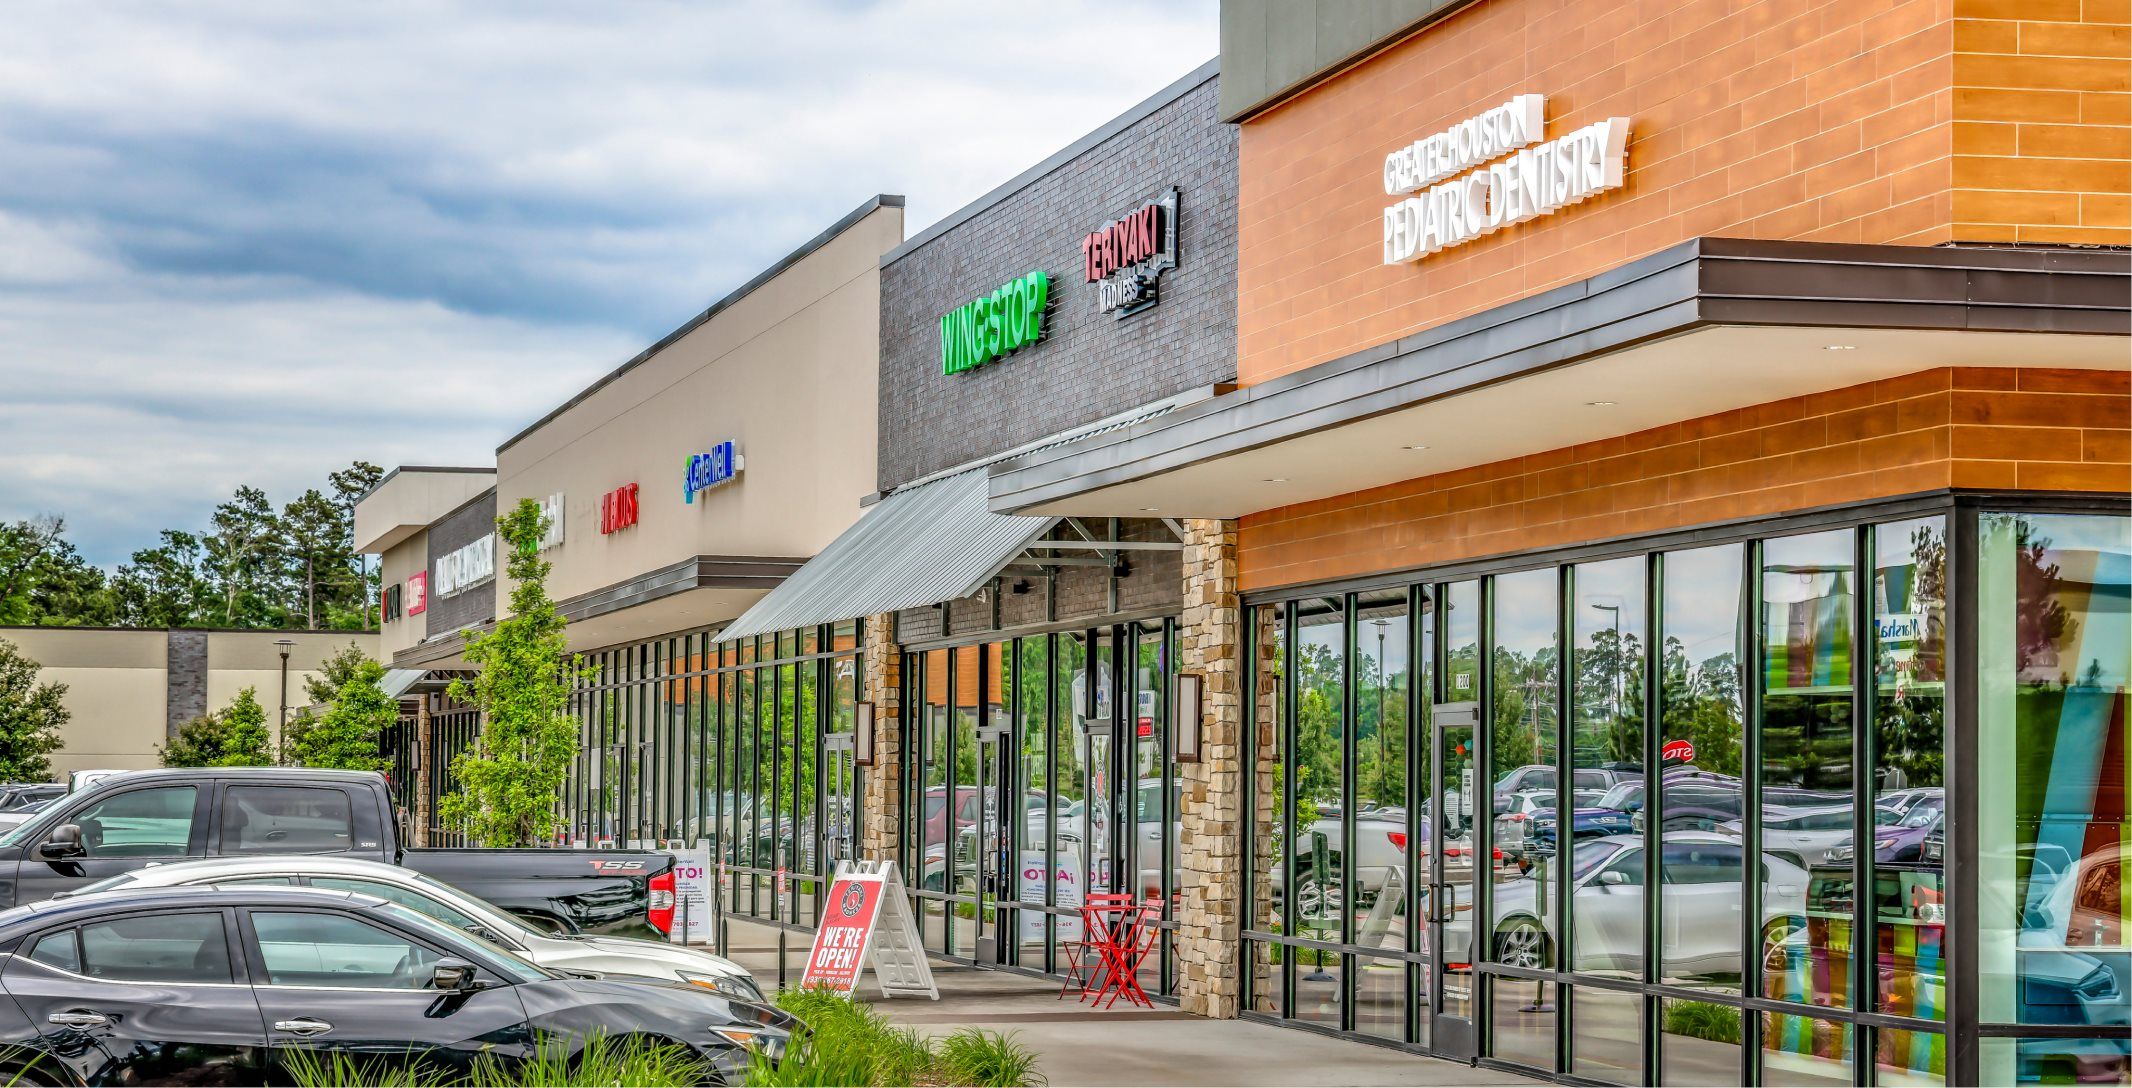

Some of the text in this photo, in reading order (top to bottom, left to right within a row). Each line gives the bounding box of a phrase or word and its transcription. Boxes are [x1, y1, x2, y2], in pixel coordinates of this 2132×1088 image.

[1384, 94, 1543, 195] GREATER HOUSTON
[1383, 117, 1630, 265] PEDIATRIC DENTISTRY
[1082, 204, 1161, 283] TERIYAKI
[1099, 274, 1139, 314] MADNESS
[588, 860, 646, 870] TSS
[675, 867, 703, 879] TO!
[822, 926, 865, 948] WE'RE
[816, 947, 858, 969] OPEN!
